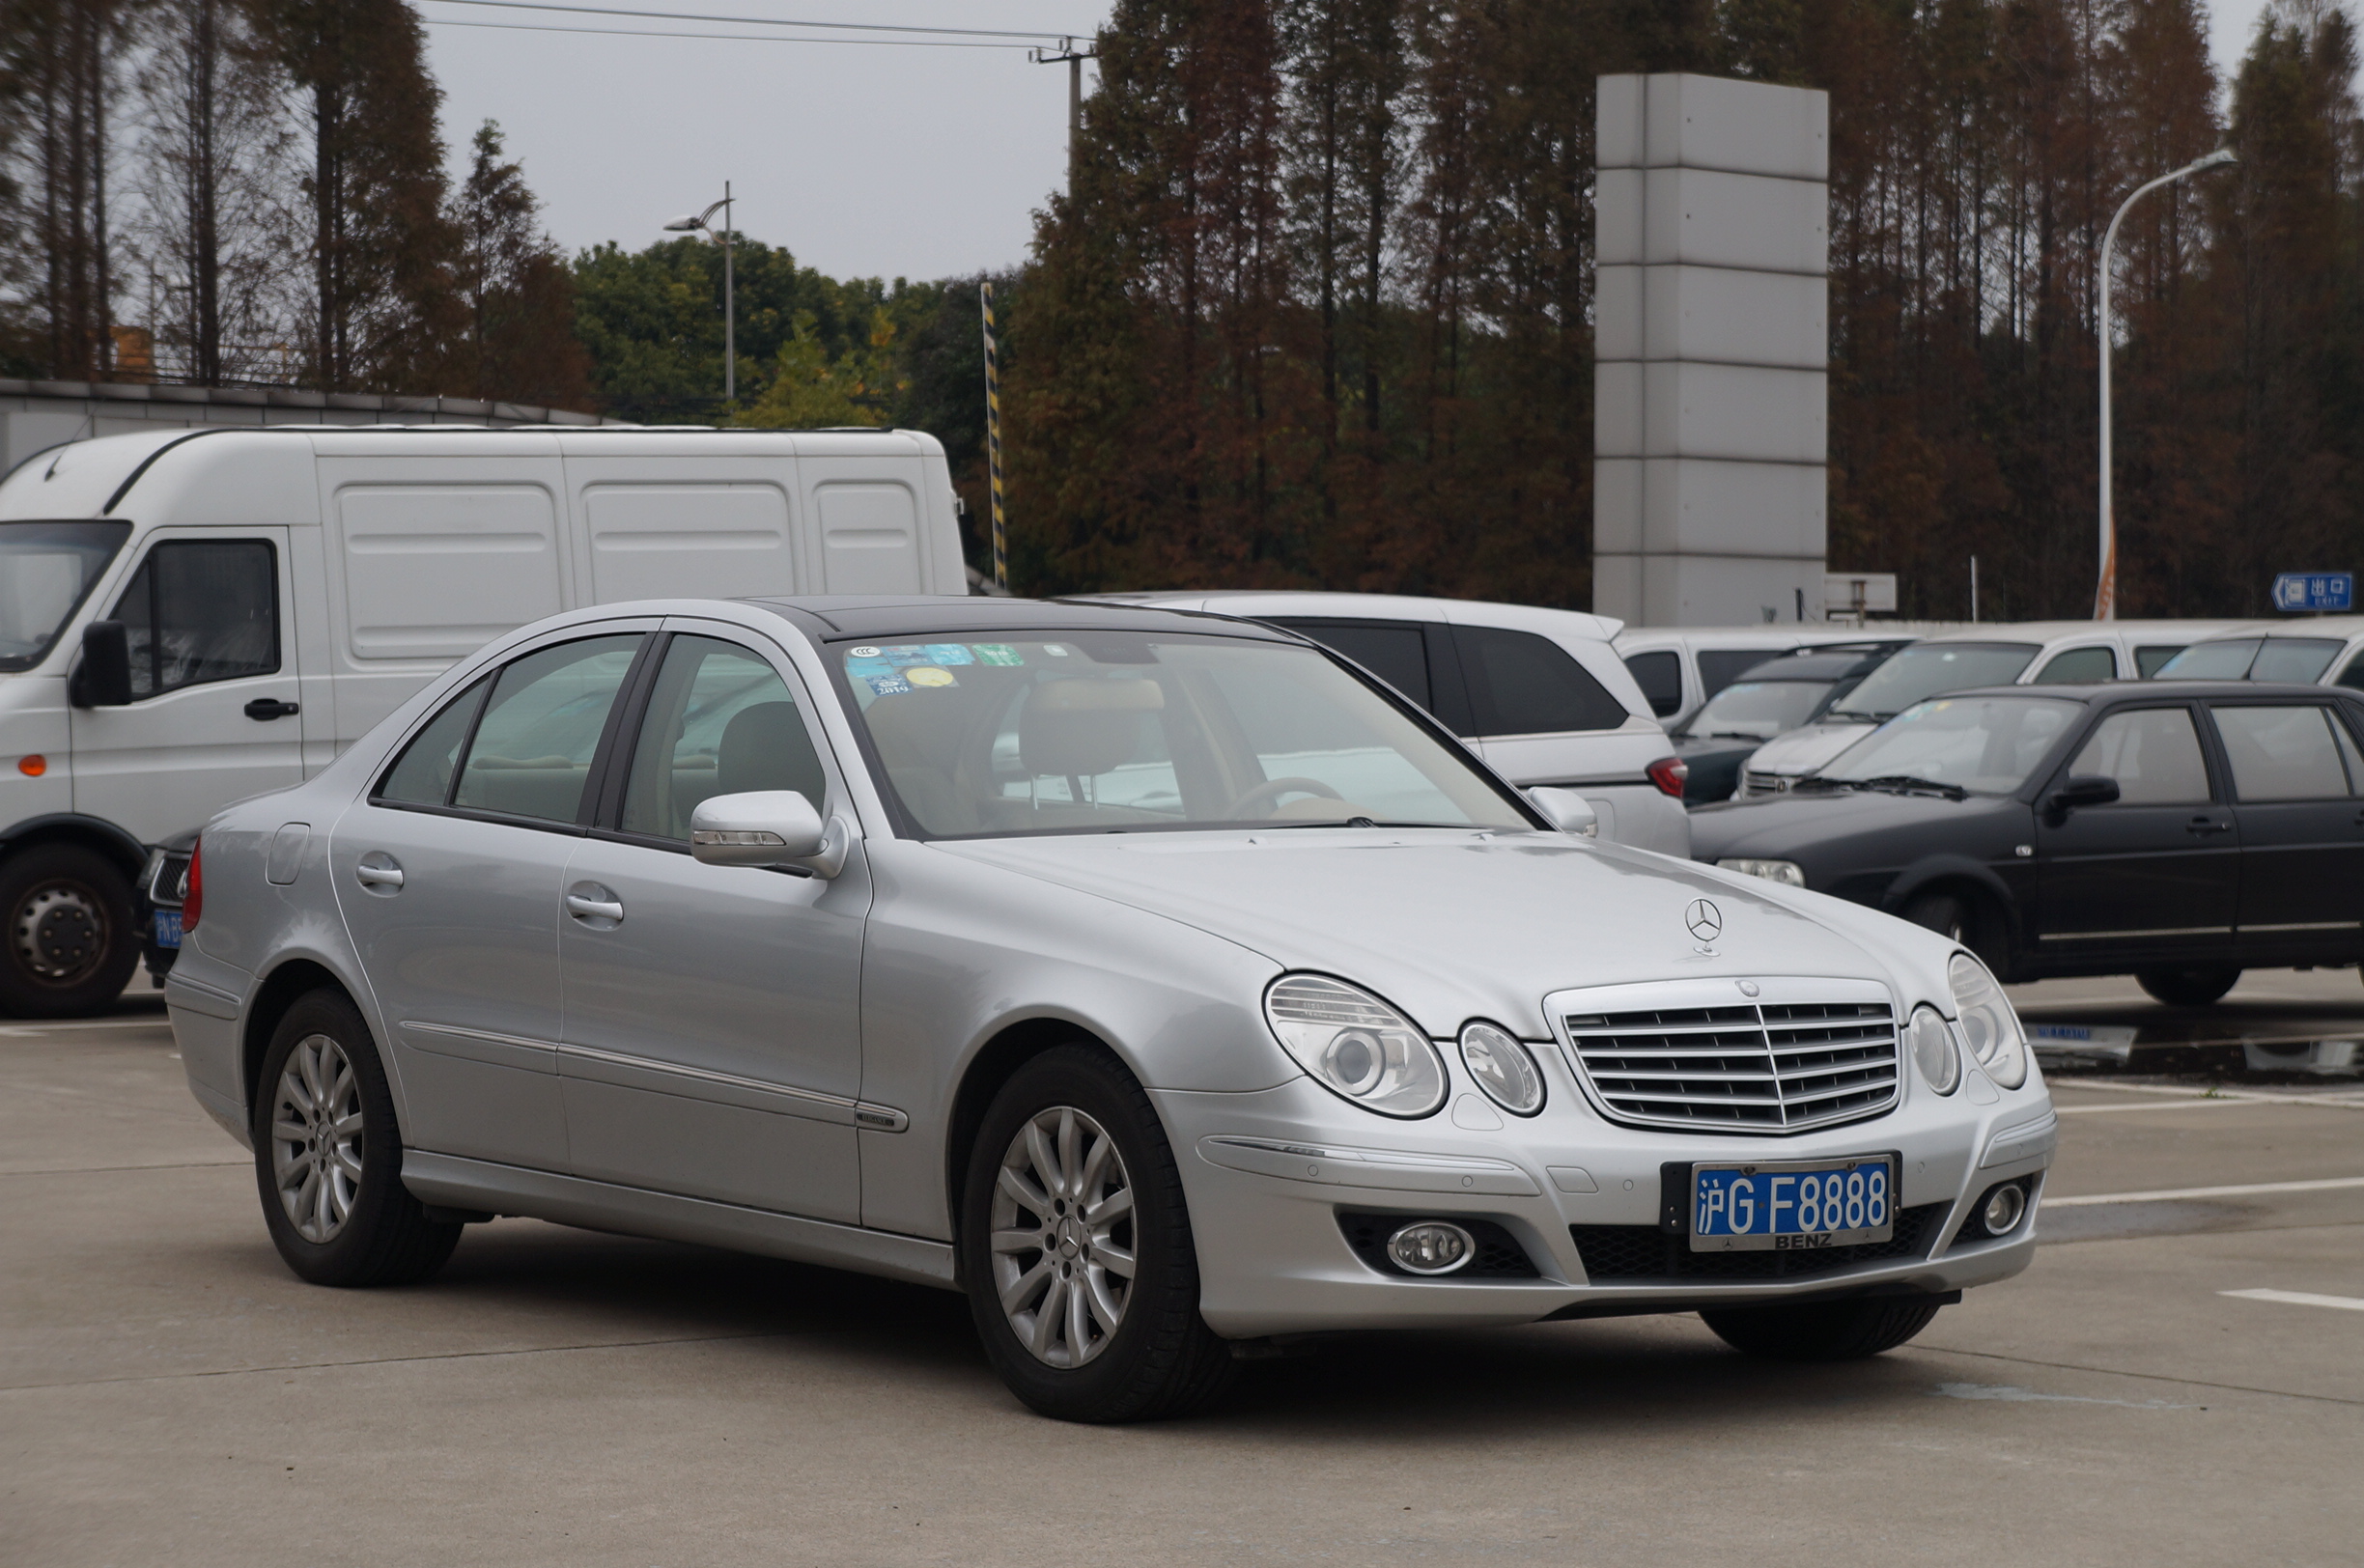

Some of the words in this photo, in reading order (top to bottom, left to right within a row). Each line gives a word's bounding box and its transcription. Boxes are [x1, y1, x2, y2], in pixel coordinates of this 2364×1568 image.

[2311, 578, 2343, 596] 出口
[877, 685, 909, 695] 2019
[1775, 1233, 1832, 1249] BENZ
